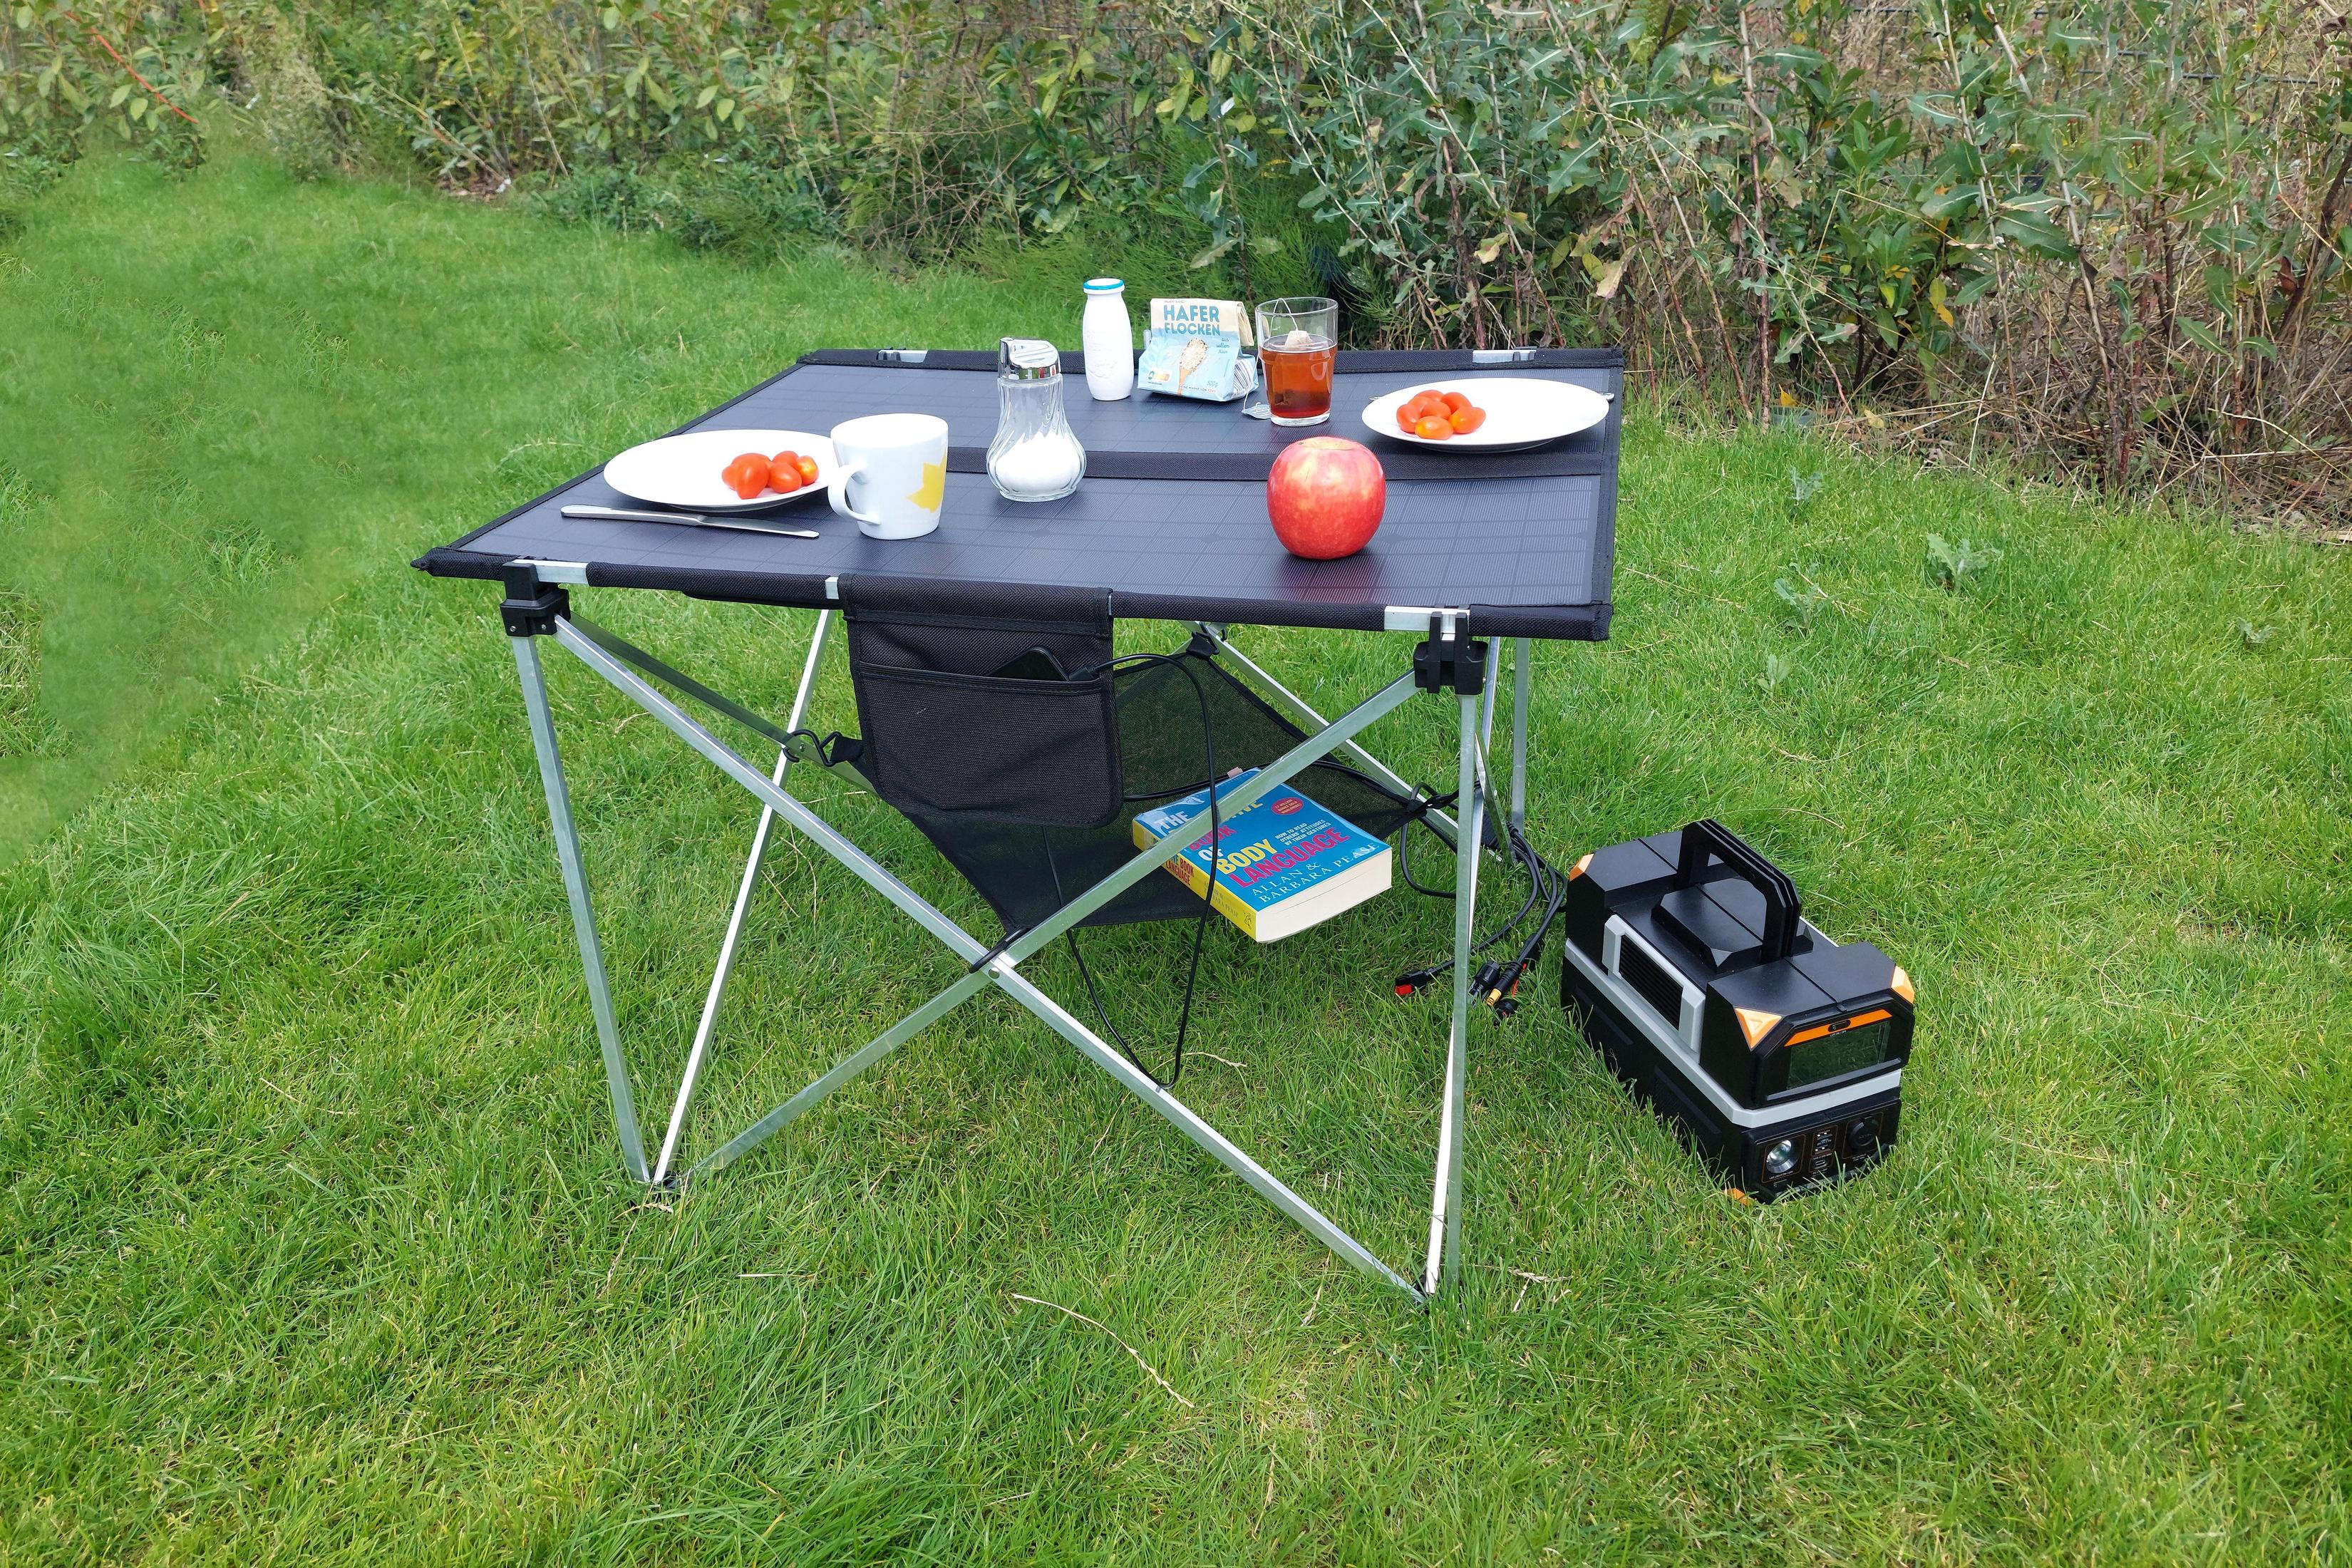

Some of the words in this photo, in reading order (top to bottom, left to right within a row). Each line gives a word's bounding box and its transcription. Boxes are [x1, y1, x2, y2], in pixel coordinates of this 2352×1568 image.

[1163, 304, 1220, 323] HAFER
[1164, 322, 1221, 336] FLOCKEN
[1154, 810, 1192, 830] THE
[1294, 822, 1307, 831] READ
[1299, 819, 1326, 833] ATTITUDES
[1292, 834, 1307, 842] THEIR
[1306, 822, 1331, 836] GESTURES
[1216, 838, 1278, 875] BODY
[1229, 827, 1351, 887] LANGUAGE
[1165, 860, 1191, 886] LANGUAGE
[1180, 857, 1195, 878] BOOK
[1259, 867, 1332, 903] BARBARA
[1334, 842, 1380, 867] PEASE
[1252, 869, 1304, 896] ALLAN
[1305, 862, 1321, 871] &
